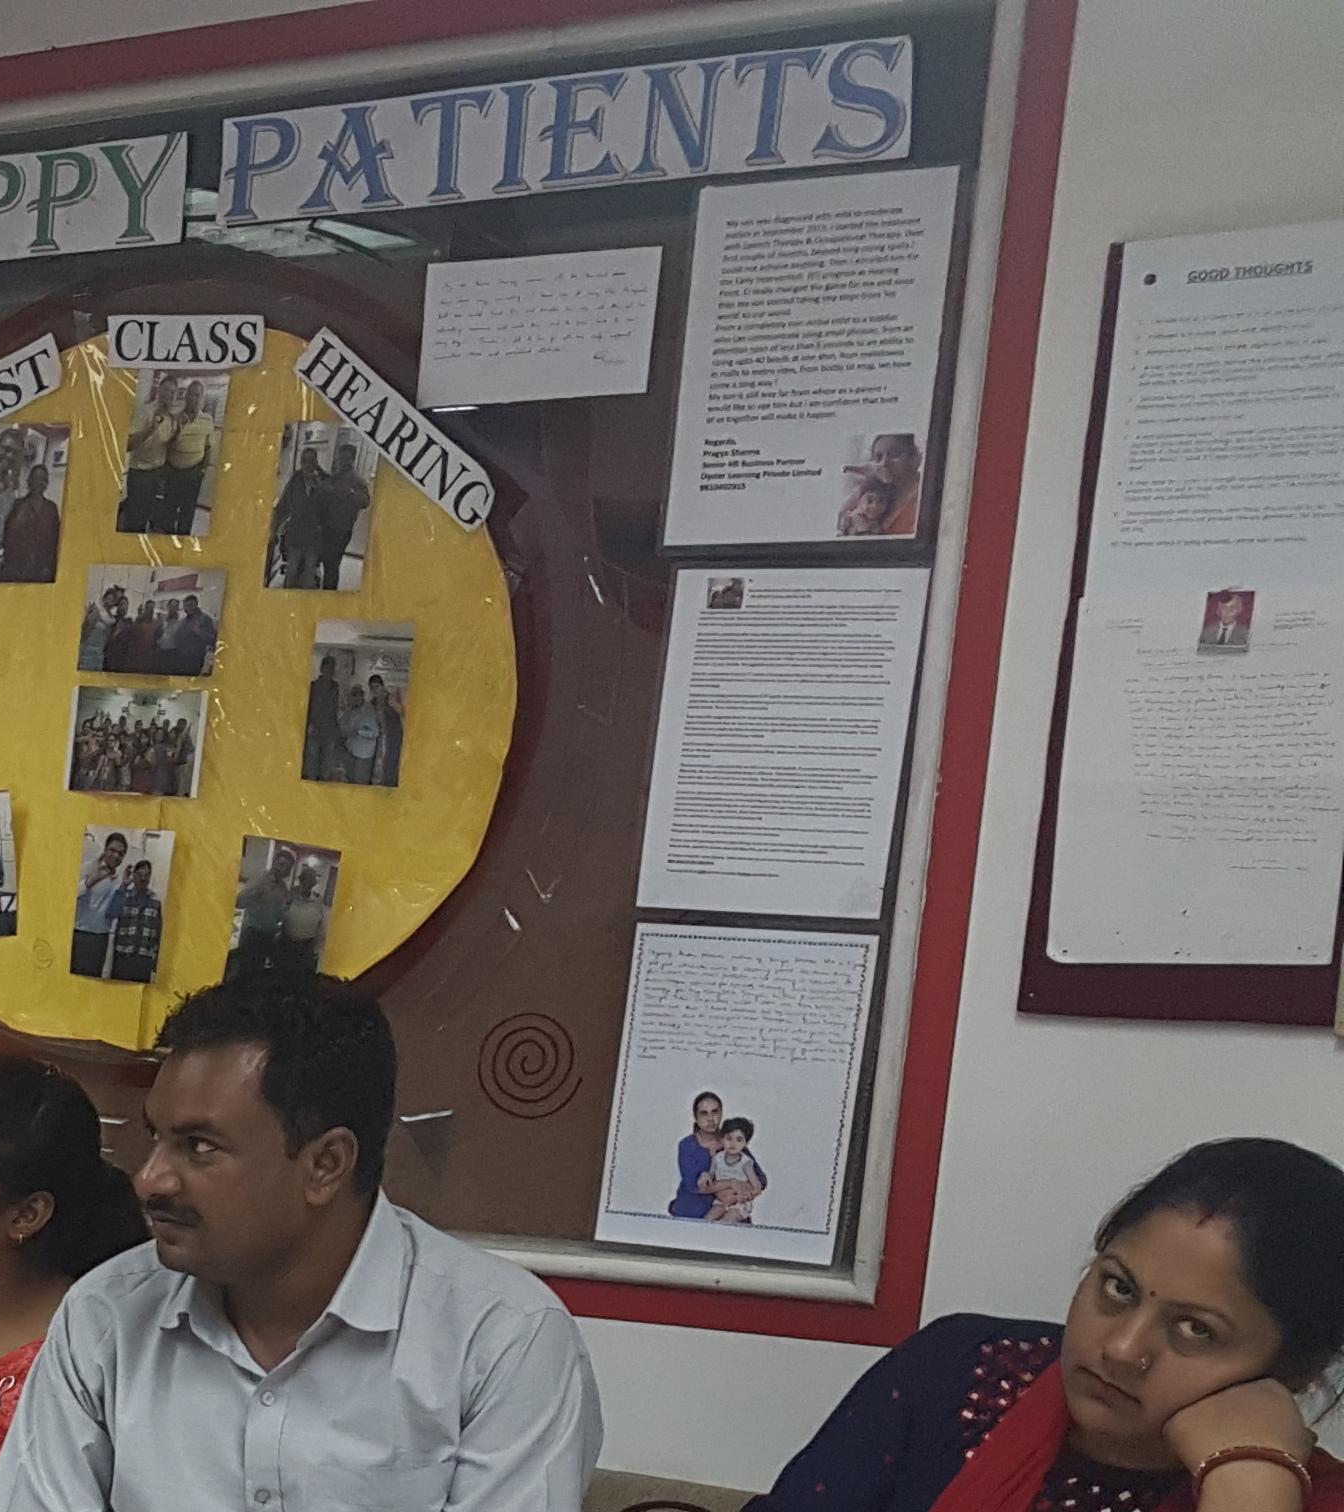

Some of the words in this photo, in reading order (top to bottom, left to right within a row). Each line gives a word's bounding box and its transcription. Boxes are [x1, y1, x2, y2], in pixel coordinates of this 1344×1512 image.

[223, 39, 908, 220] PATIENTS
[1187, 268, 1229, 283] GOOD
[1234, 261, 1313, 279] THOUGHTS
[114, 320, 258, 364] CLASS
[299, 338, 490, 528] HEARING
